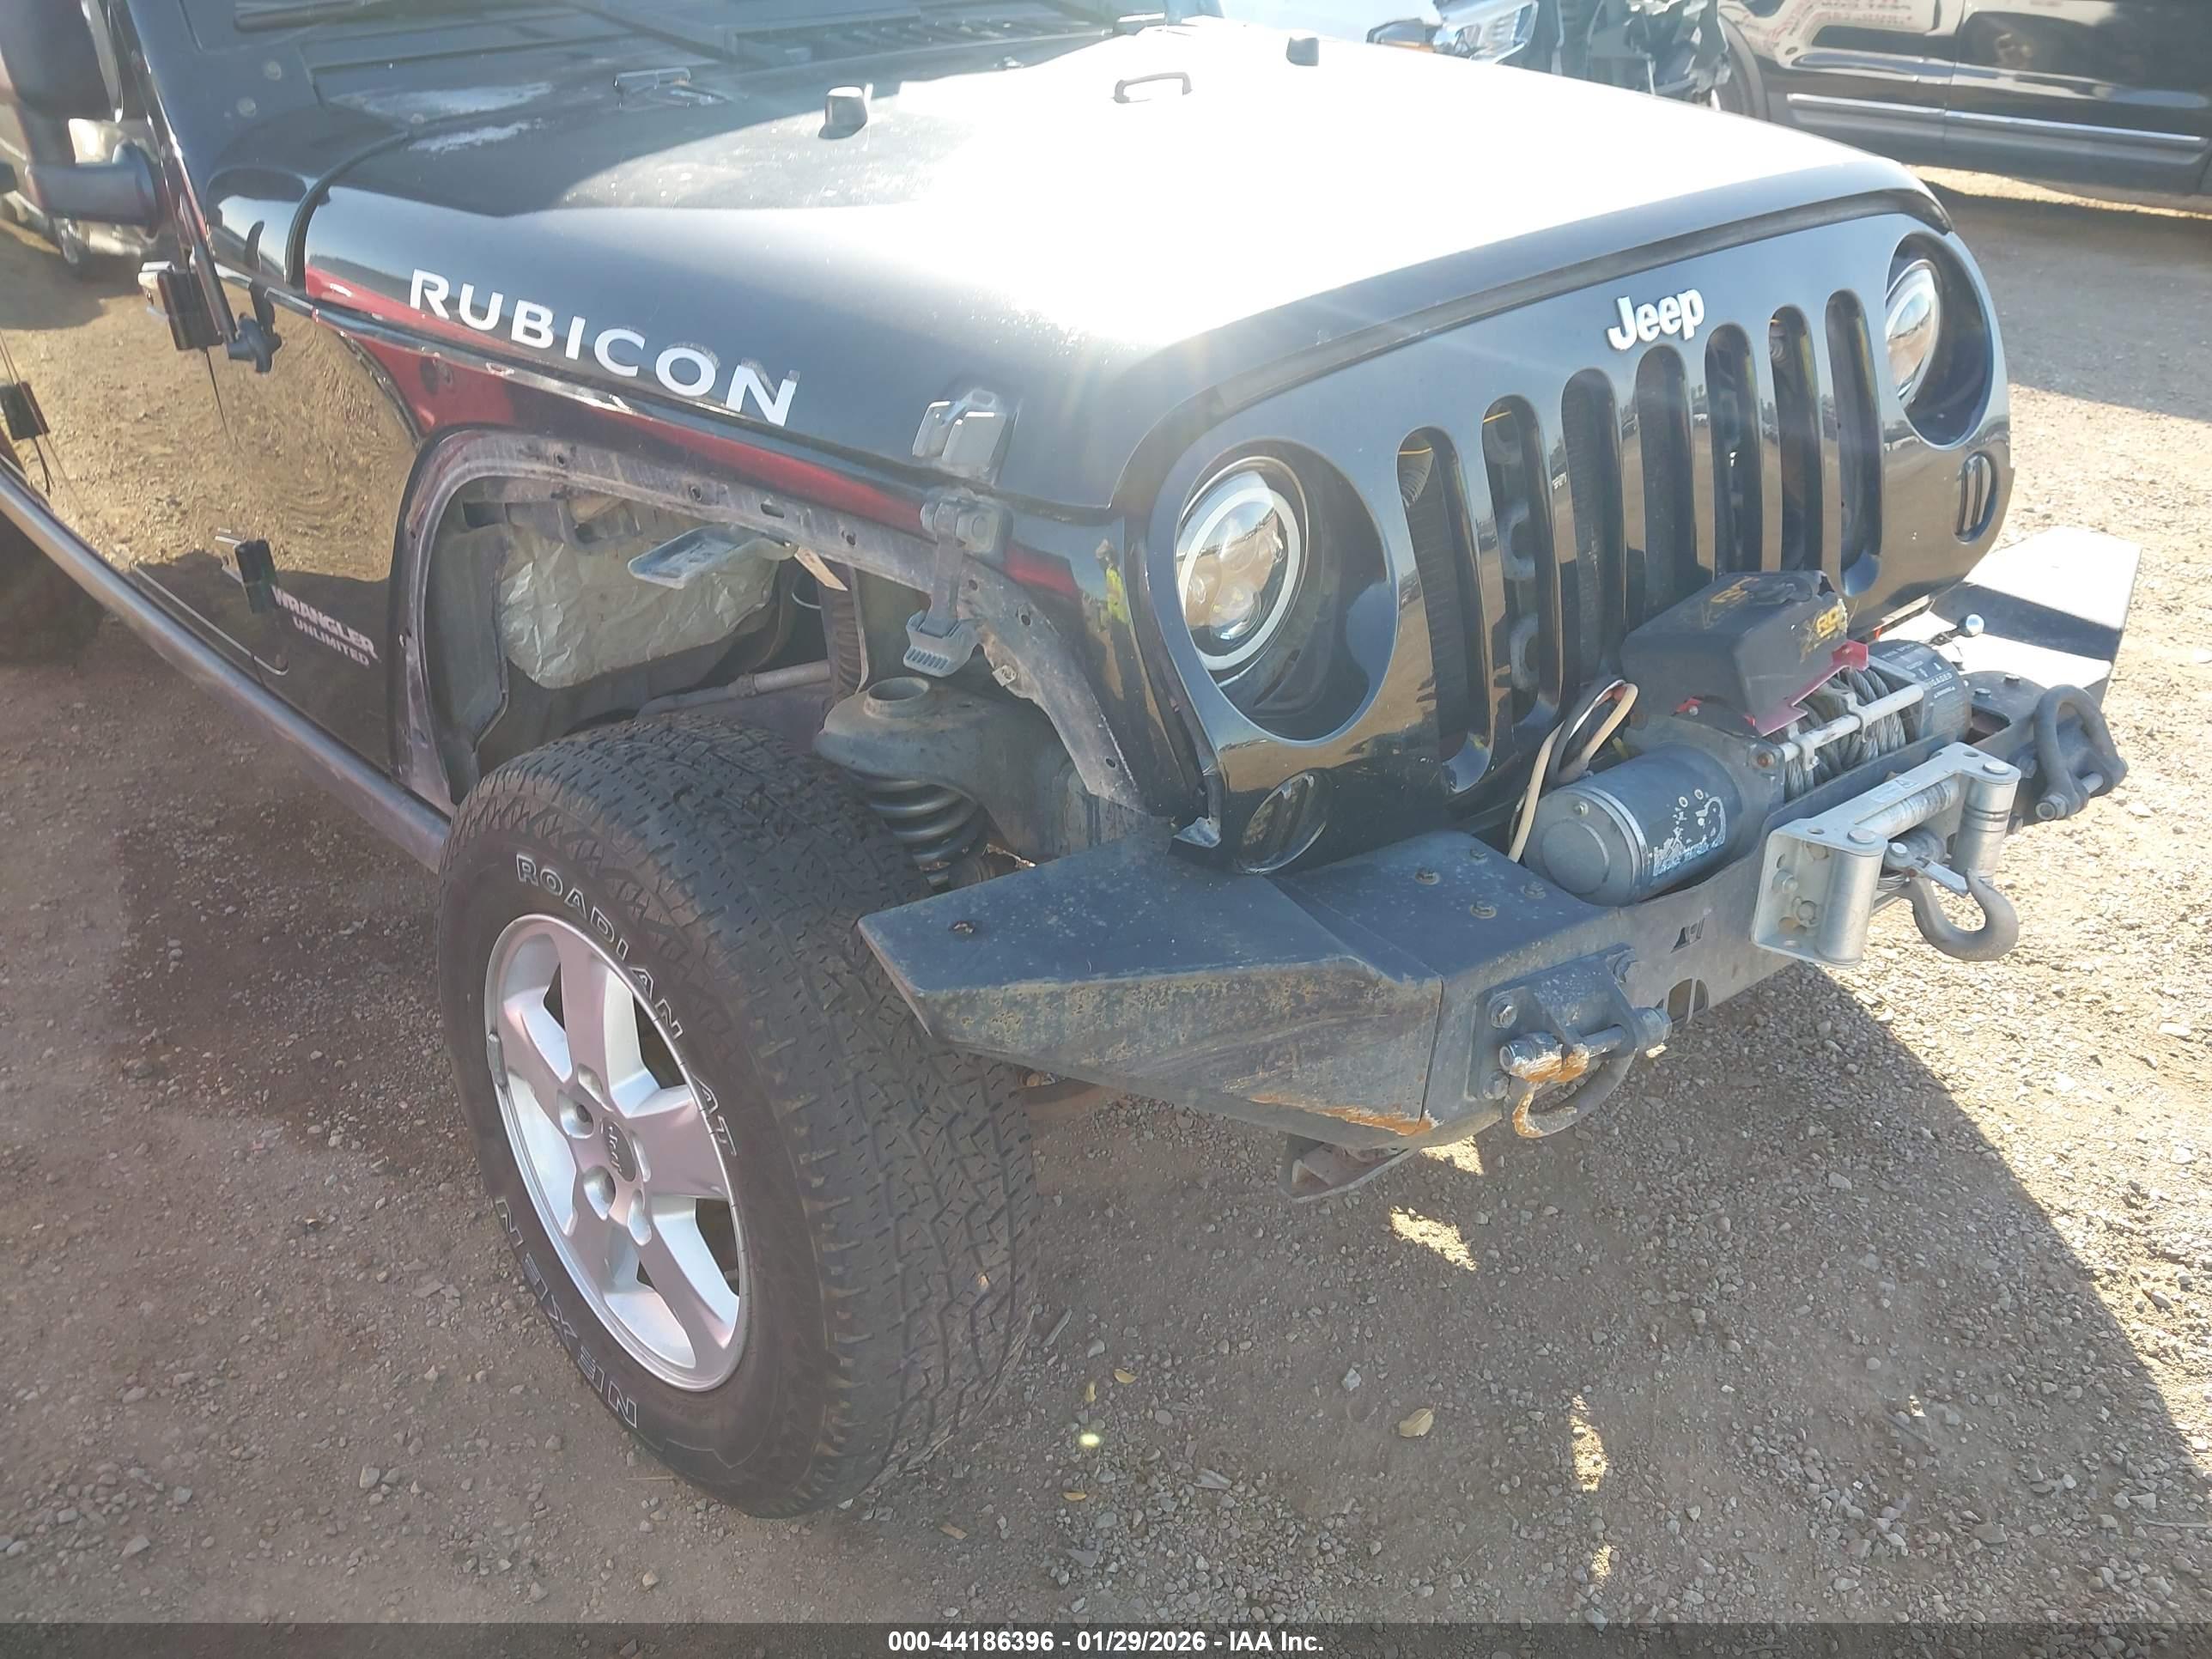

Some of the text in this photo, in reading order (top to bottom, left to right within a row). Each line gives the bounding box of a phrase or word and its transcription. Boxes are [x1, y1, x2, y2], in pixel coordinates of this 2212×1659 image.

[410, 268, 799, 427] RUBICON
[1607, 289, 1705, 350] Jeep
[270, 583, 380, 659] WRANGLER
[293, 615, 370, 667] UNLIMITED
[516, 854, 738, 1156] ROADIAN AT
[495, 1196, 637, 1429] NEXEN
